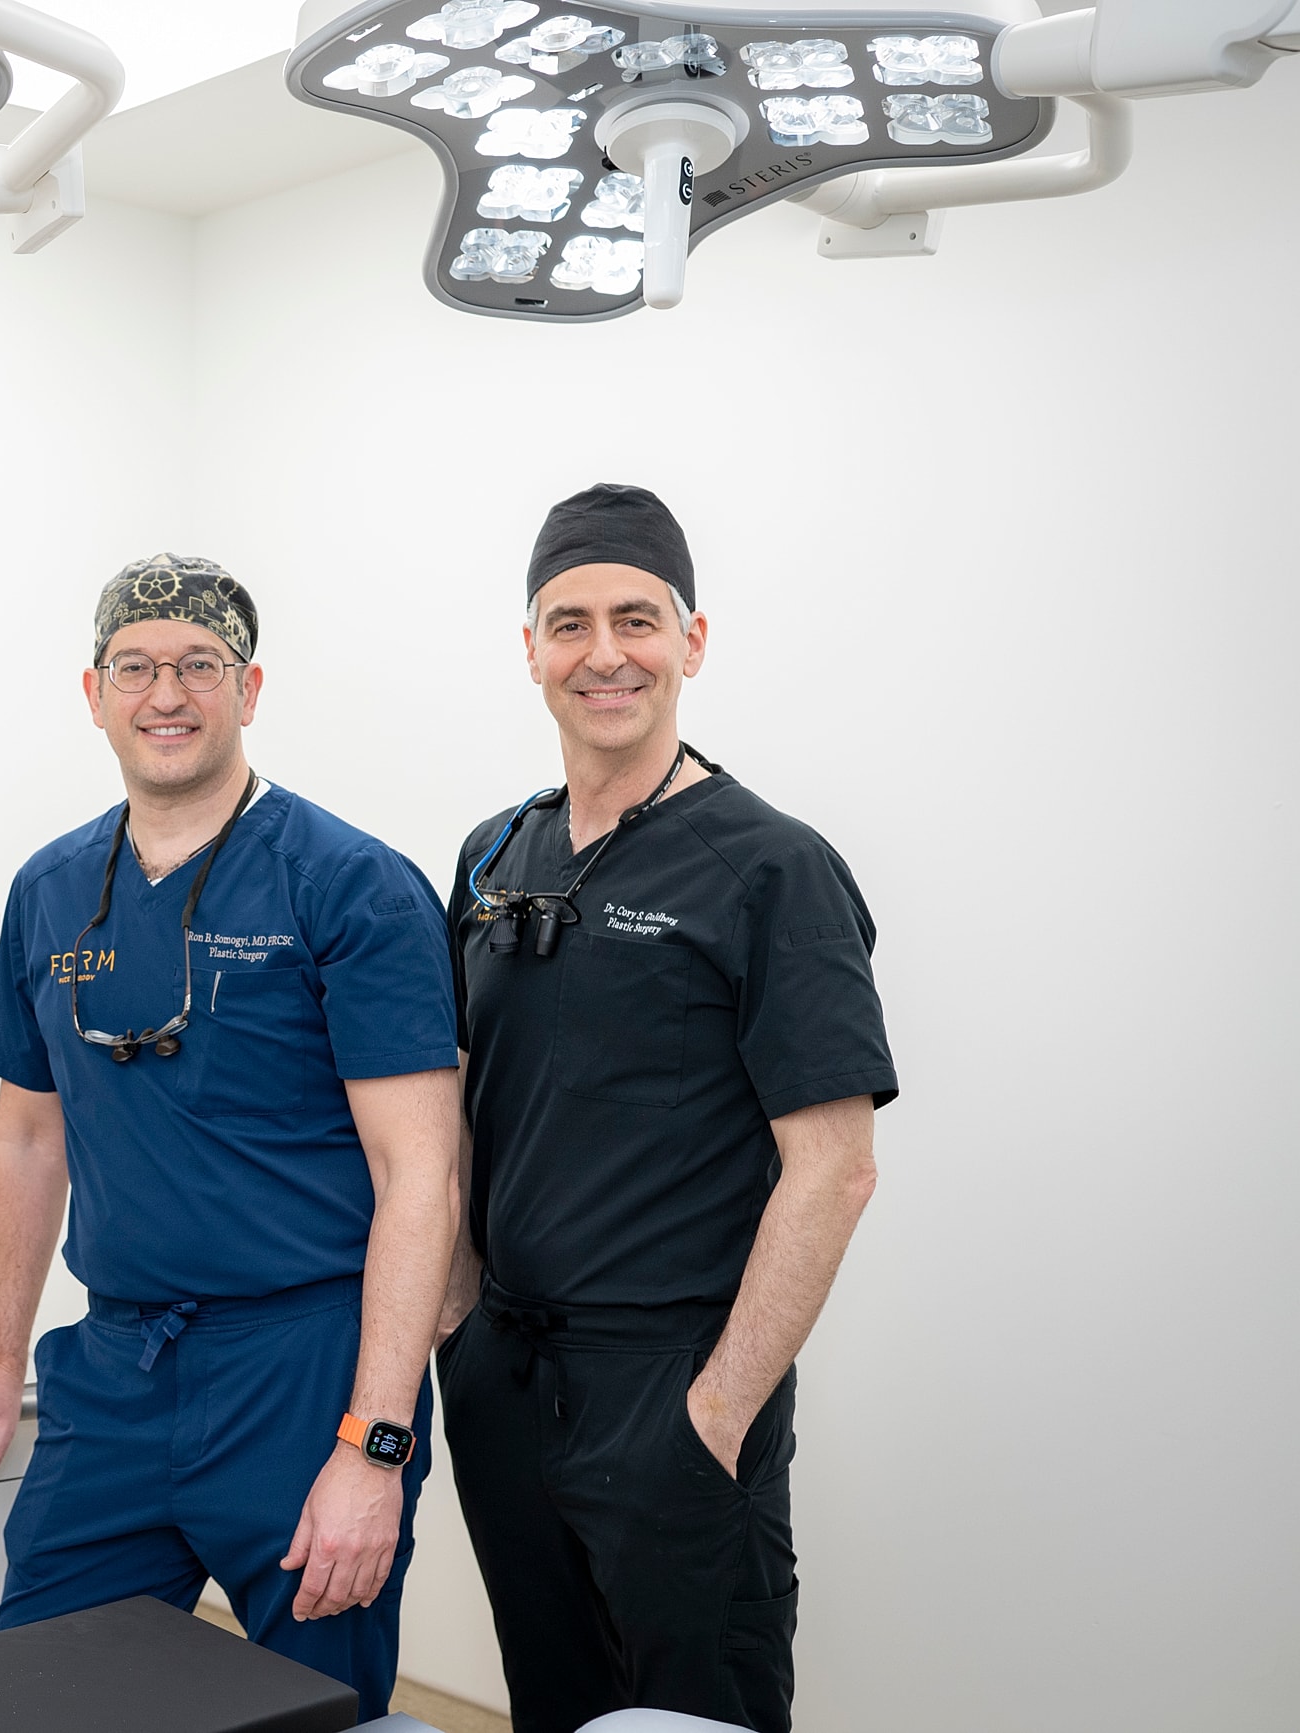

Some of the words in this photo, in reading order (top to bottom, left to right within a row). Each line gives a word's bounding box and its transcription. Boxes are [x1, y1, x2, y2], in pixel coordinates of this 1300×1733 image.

[616, 905, 637, 921] Cory
[606, 916, 634, 933] Plastic
[633, 923, 662, 937] Surgery
[187, 930, 204, 942] Ron
[204, 932, 213, 944] B.
[213, 933, 251, 948] Somogyi,
[251, 935, 267, 946] MD
[267, 935, 294, 947] FRCSC
[208, 946, 237, 960] Plastic
[237, 948, 269, 963] Surgery
